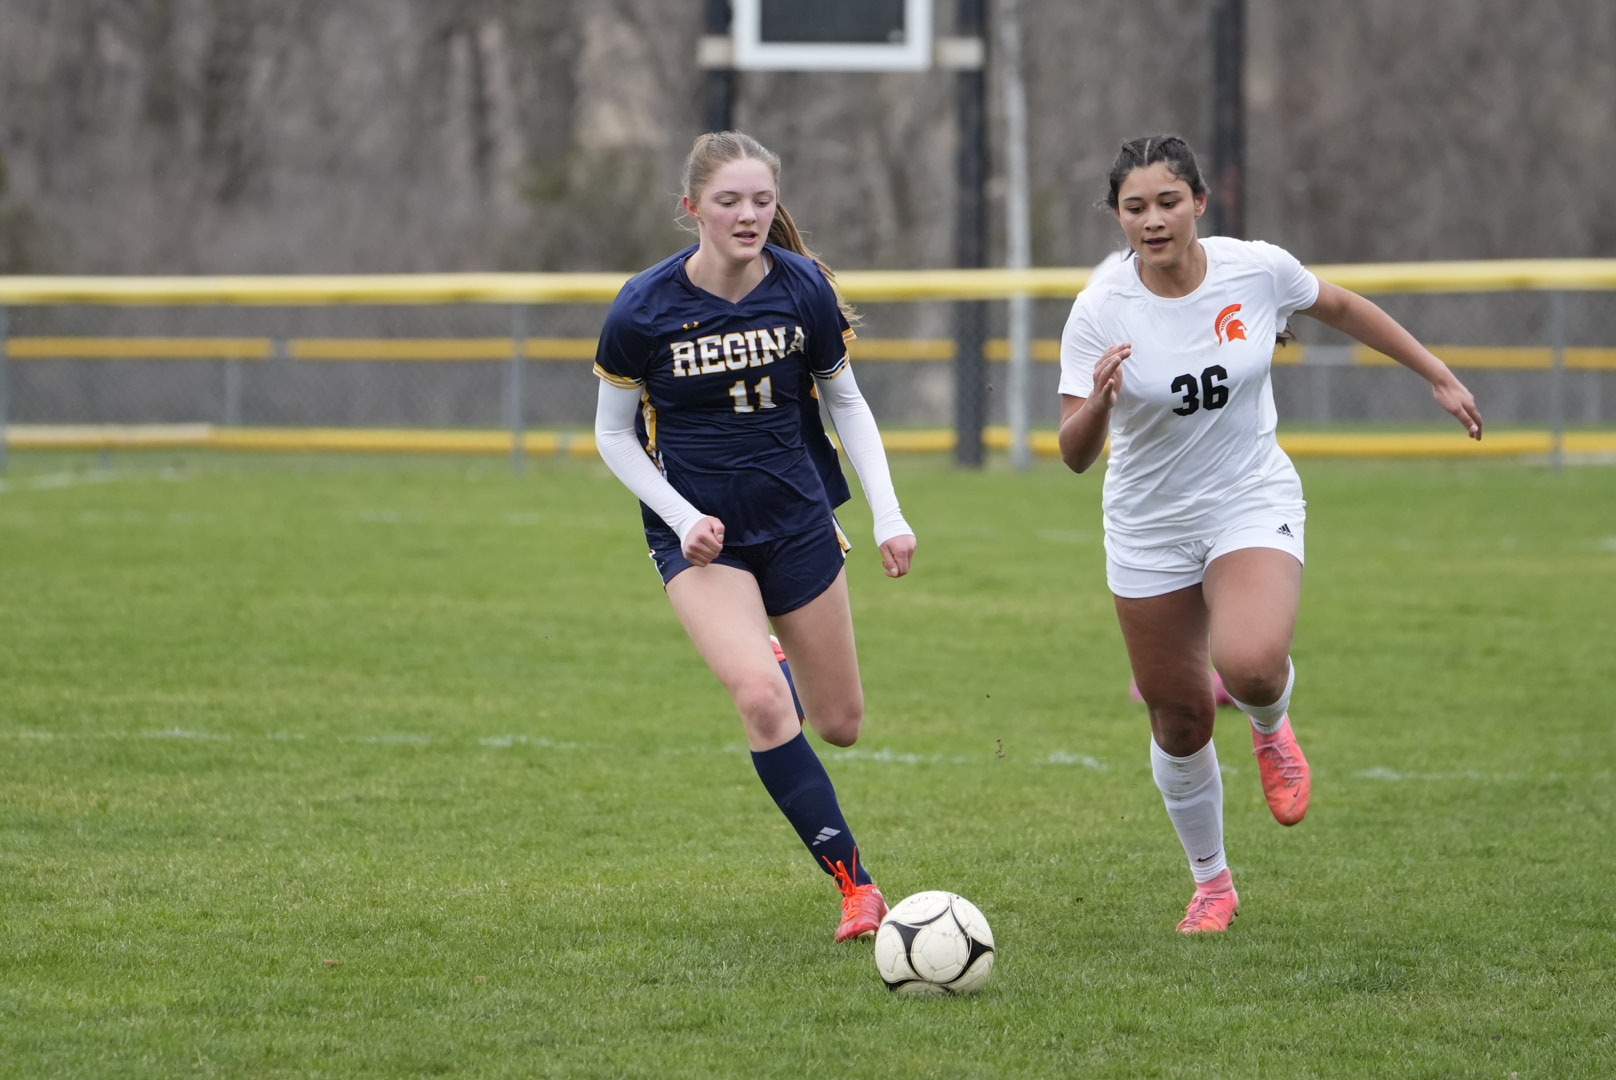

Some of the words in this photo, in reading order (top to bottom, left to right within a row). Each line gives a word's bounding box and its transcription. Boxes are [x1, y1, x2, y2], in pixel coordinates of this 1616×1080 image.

[670, 326, 805, 378] REGINA
[728, 375, 778, 414] 11
[1171, 364, 1230, 417] 36
